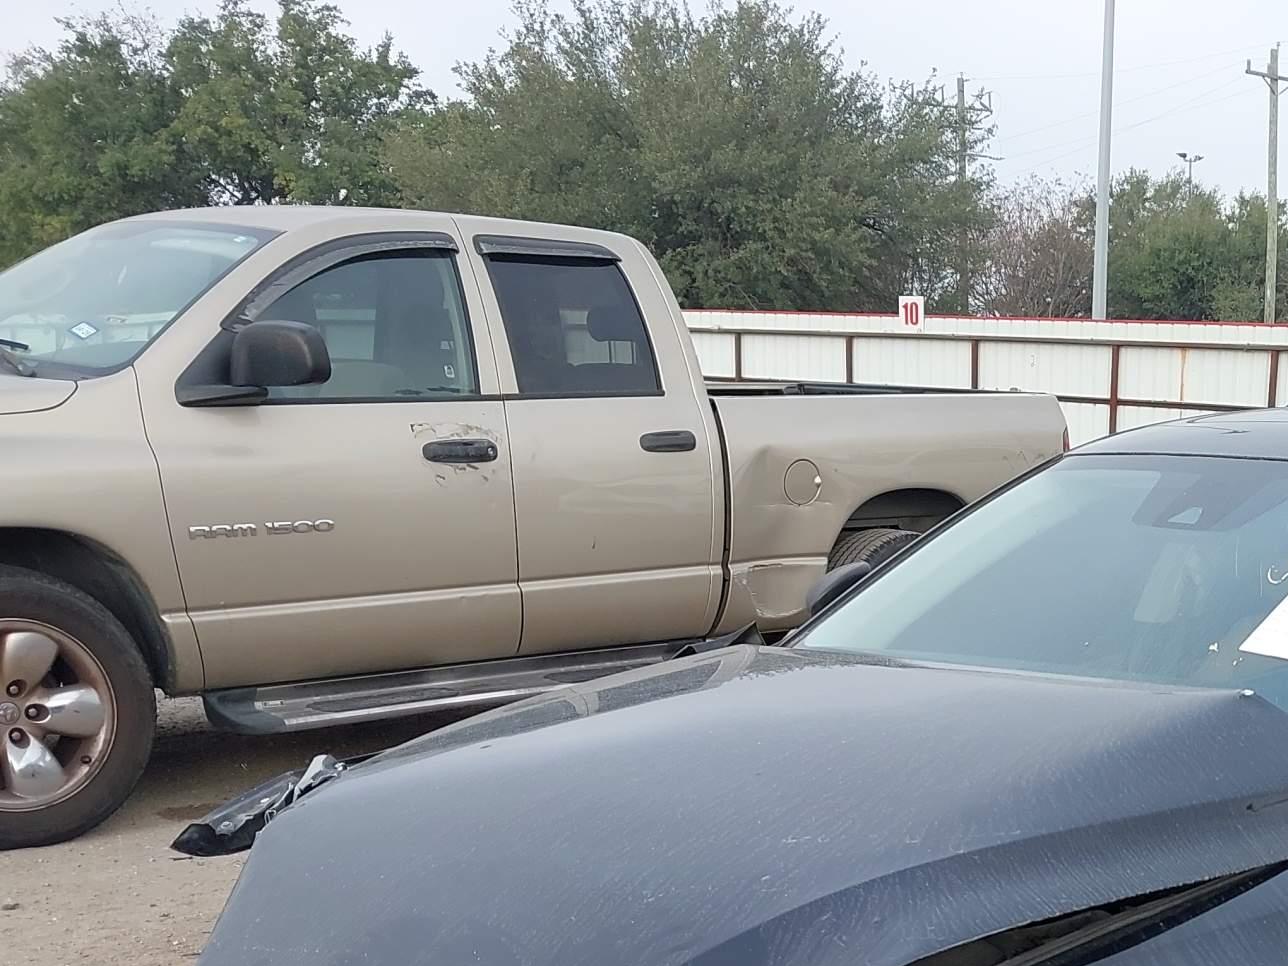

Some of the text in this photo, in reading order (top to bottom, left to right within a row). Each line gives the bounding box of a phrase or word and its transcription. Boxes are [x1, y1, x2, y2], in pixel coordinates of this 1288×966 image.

[902, 302, 918, 325] 10
[189, 519, 335, 539] RAM 1500
